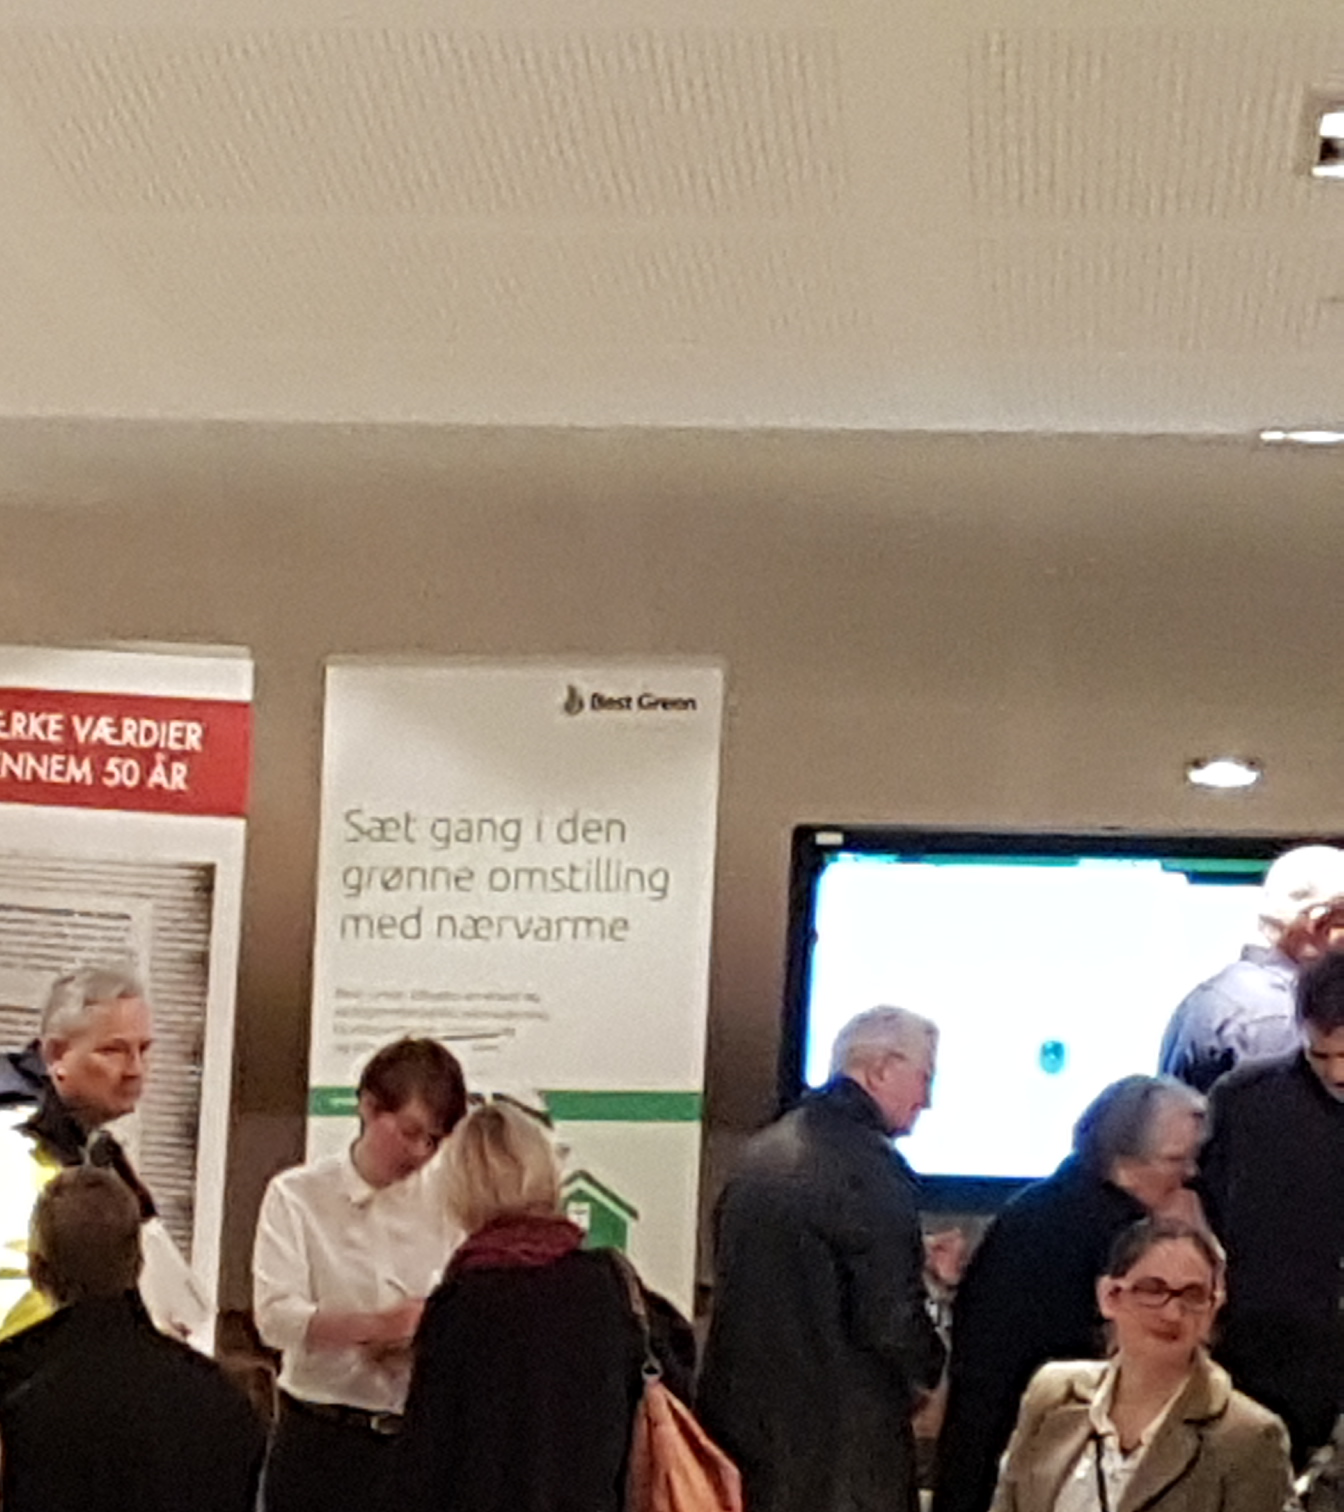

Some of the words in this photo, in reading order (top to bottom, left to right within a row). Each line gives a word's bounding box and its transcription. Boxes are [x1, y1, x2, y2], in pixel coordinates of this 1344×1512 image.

[72, 714, 203, 751] VÆRDIER
[102, 757, 140, 788] 50
[146, 752, 189, 790] ÅR
[344, 809, 416, 845] Sæt
[430, 816, 522, 852] gang
[535, 810, 544, 844] i
[557, 810, 626, 845] den
[341, 866, 475, 899] grønne
[488, 857, 671, 901] omstilling
[340, 906, 424, 941] med
[436, 914, 630, 942] nærvarme
